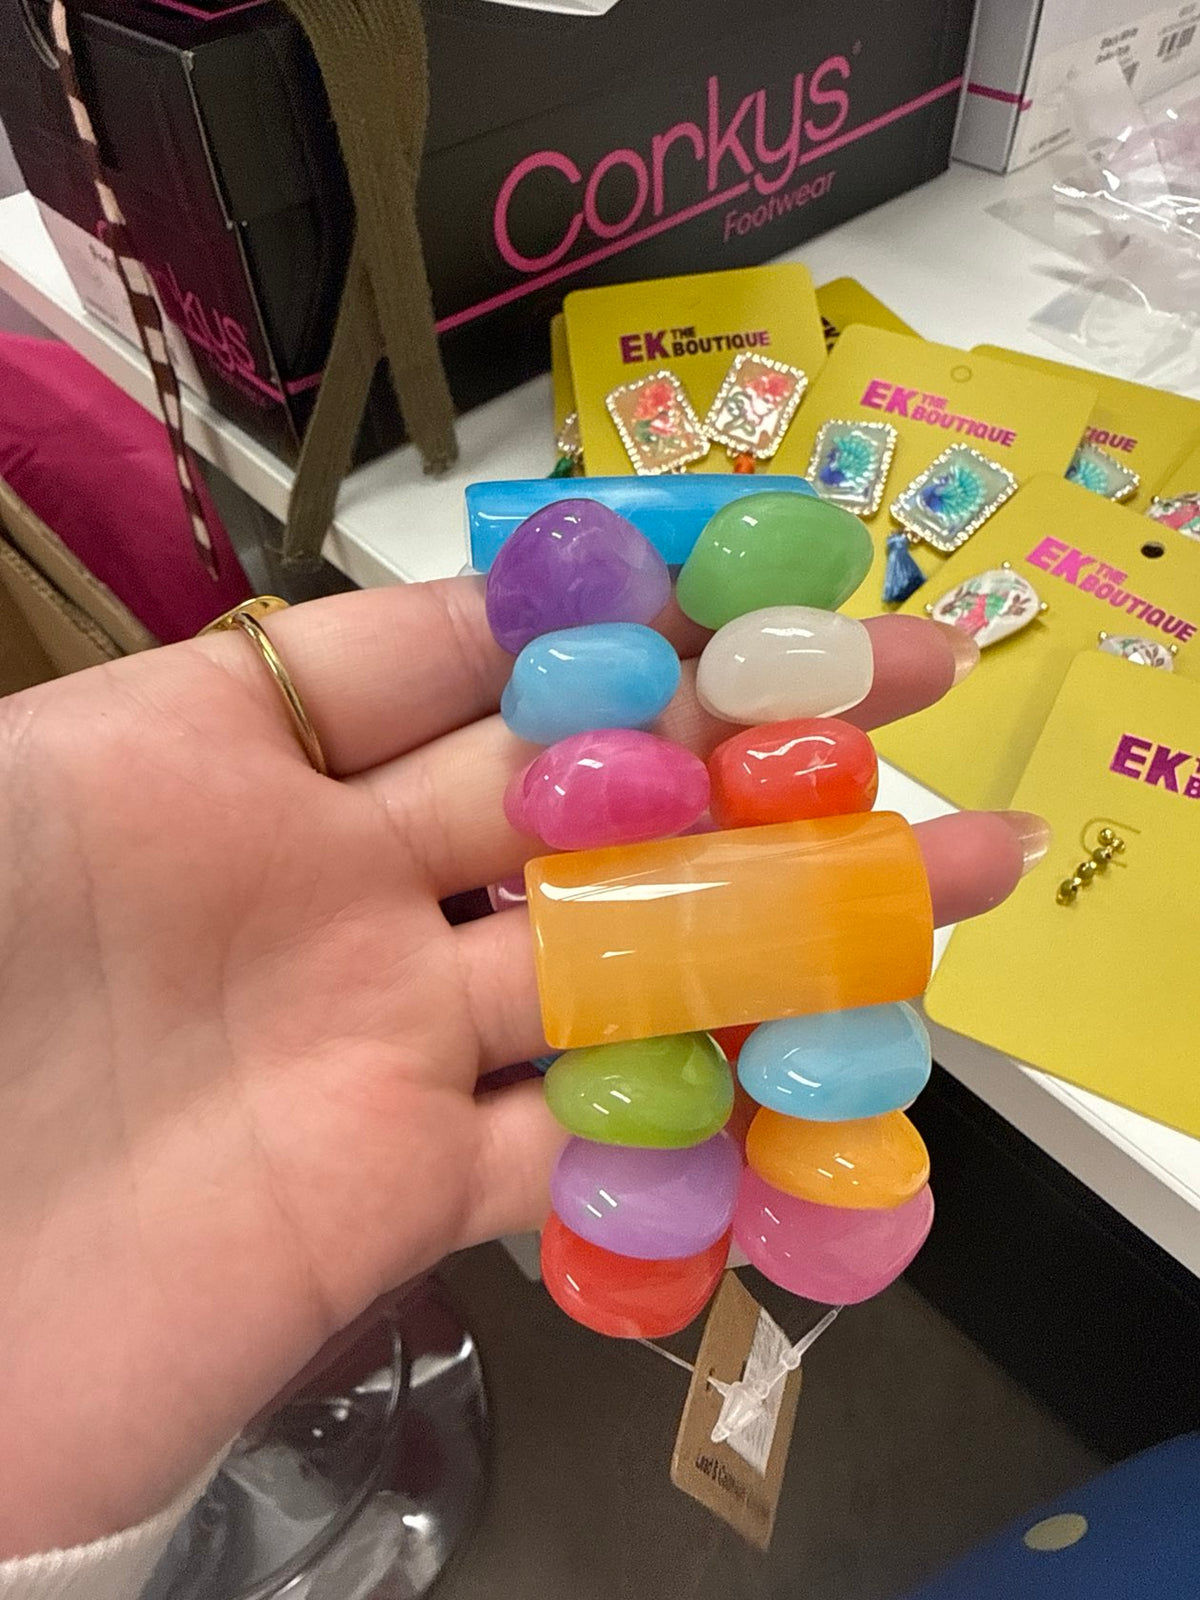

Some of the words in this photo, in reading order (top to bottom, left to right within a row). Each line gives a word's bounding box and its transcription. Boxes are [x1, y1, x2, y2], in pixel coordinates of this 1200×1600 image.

[494, 55, 850, 273] Corkys
[723, 170, 836, 243] Footwear
[620, 330, 670, 364] EK
[671, 326, 695, 340] THE
[671, 330, 771, 357] BOUTIQUE
[860, 379, 918, 417] EK
[919, 392, 948, 410] THE
[910, 406, 1017, 447] BOUTIQUE
[1025, 536, 1097, 585] EK
[1094, 562, 1129, 586] THE
[1079, 574, 1198, 643] BOUTIQUE
[1109, 734, 1192, 793] EK
